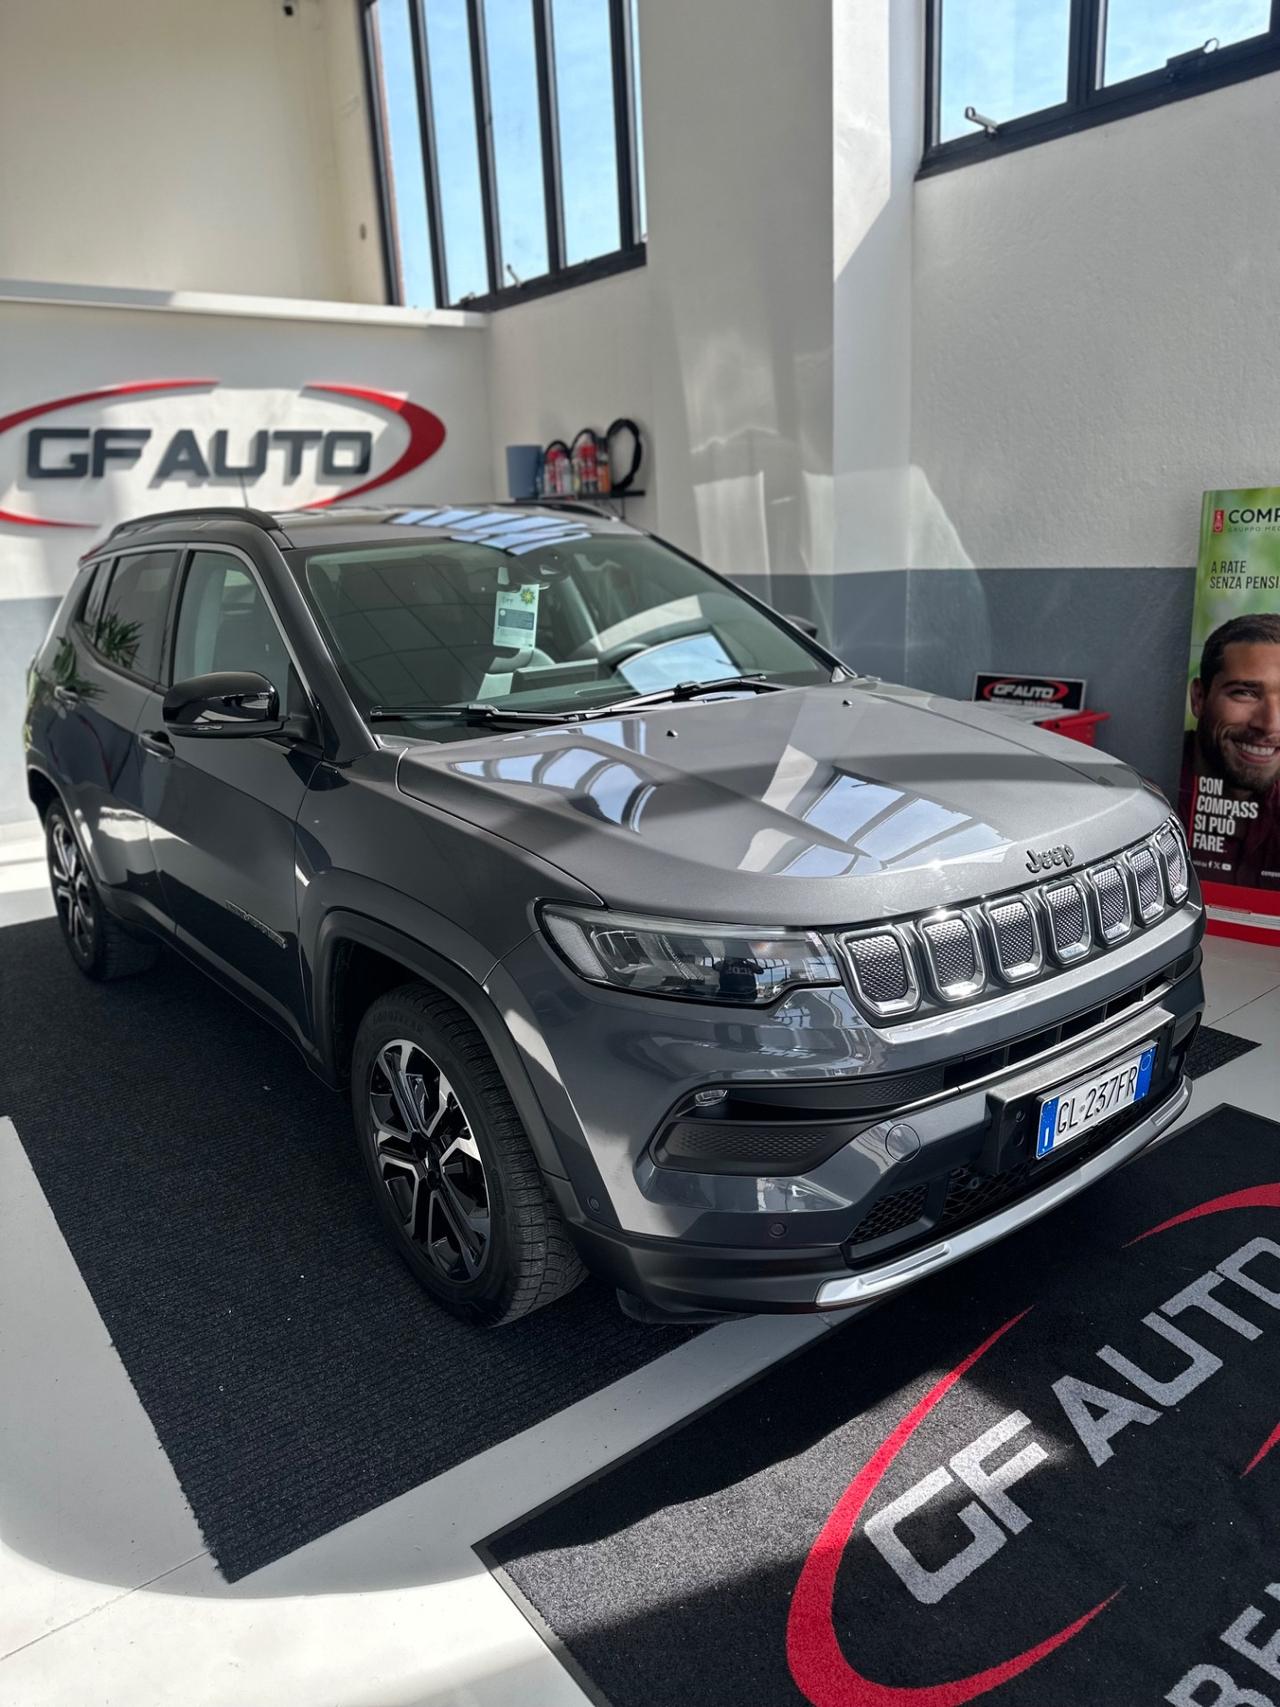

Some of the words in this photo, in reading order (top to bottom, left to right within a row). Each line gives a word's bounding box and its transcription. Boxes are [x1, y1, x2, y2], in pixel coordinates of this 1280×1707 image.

[26, 428, 152, 480] GF
[155, 429, 373, 477] AUTO
[1211, 560, 1217, 574] A
[1220, 560, 1247, 574] RATE
[1210, 576, 1242, 589] SENZA
[1245, 576, 1279, 589] PENSI
[1199, 776, 1223, 796] CON
[1196, 795, 1259, 819] COMPASS
[1194, 814, 1206, 831] SI
[1208, 815, 1236, 835] PUÒ
[1025, 844, 1075, 874] Jeep
[864, 1410, 1049, 1604] GF
[1051, 1236, 1280, 1467] AUTO
[1164, 1583, 1280, 1707] BE
